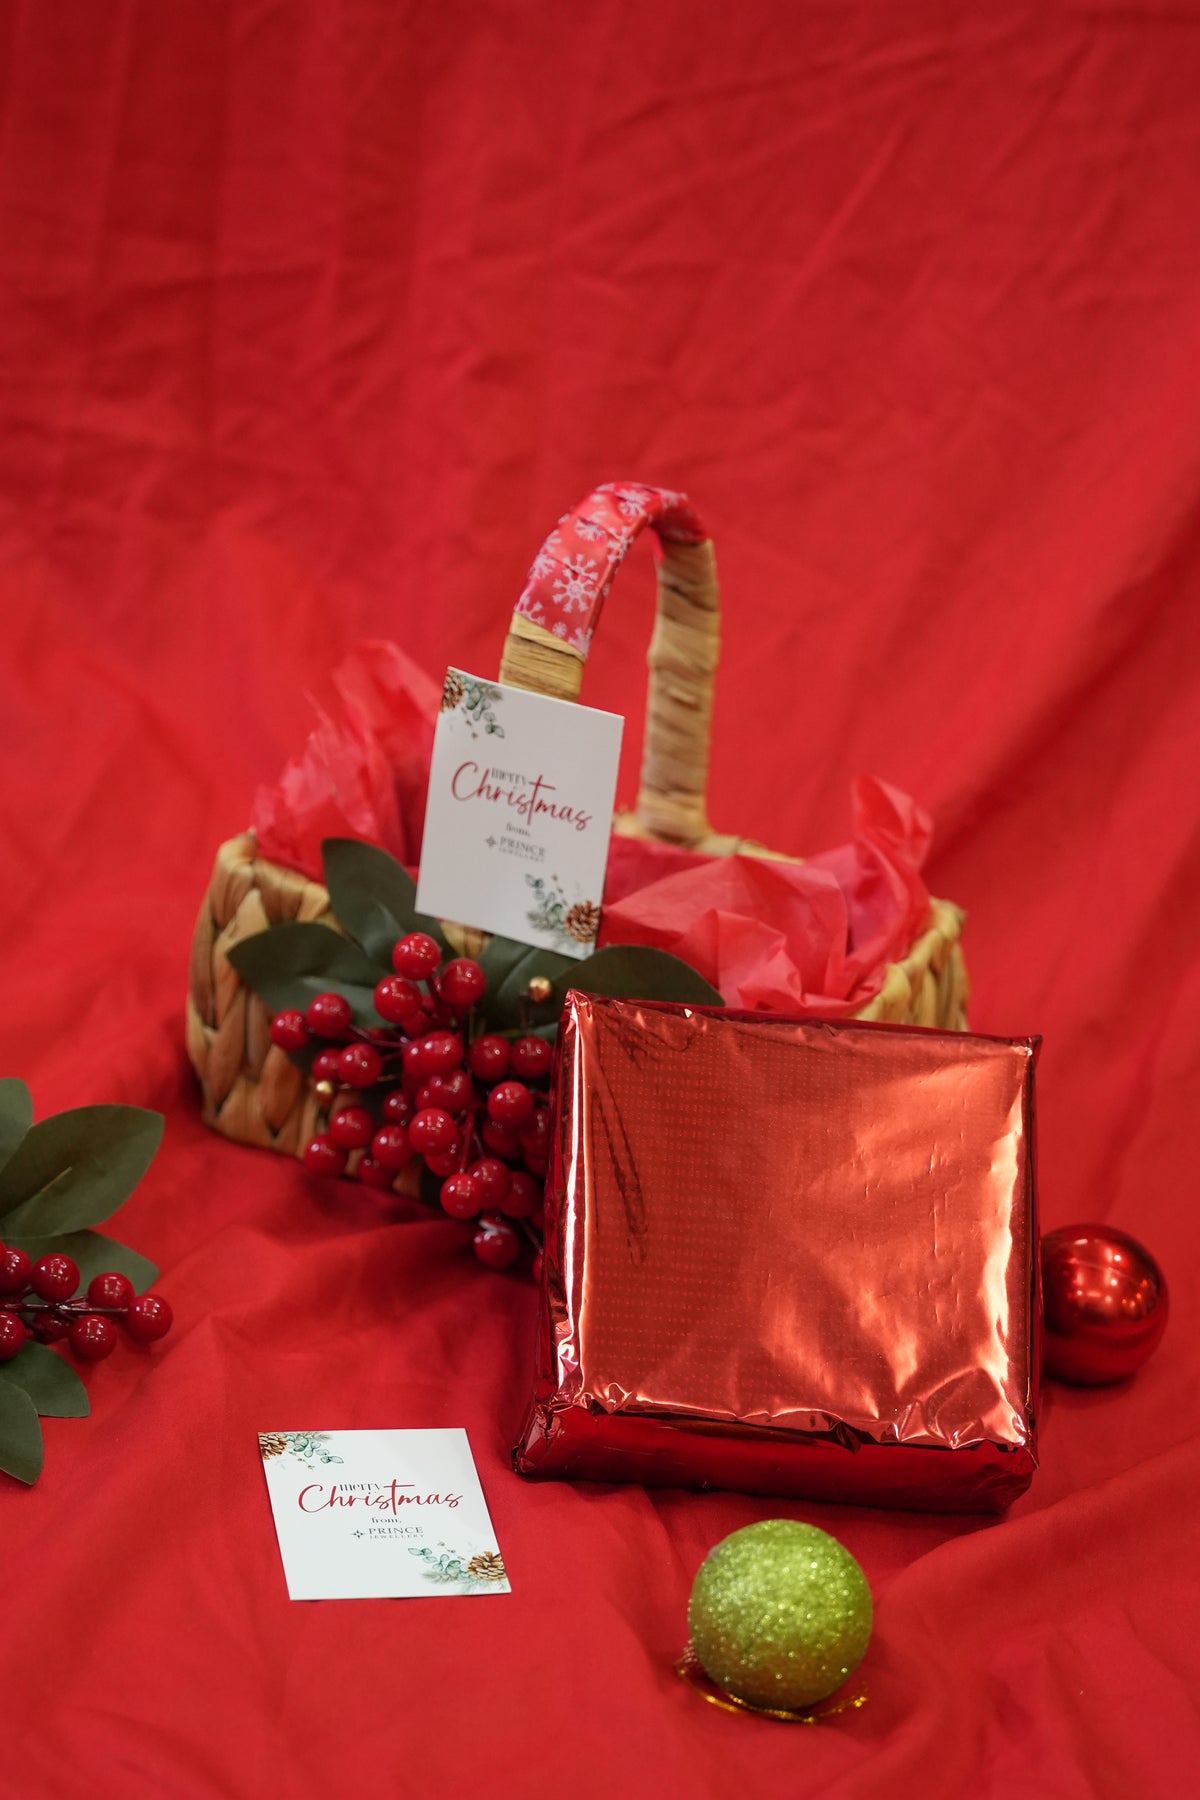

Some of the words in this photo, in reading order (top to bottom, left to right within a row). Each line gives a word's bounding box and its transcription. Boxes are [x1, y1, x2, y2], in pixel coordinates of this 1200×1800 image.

[451, 761, 593, 831] Christmas
[500, 836, 546, 857] PRINCE
[298, 1478, 463, 1515] Christmas
[339, 1483, 383, 1494] merry
[369, 1526, 424, 1534] PRINCE
